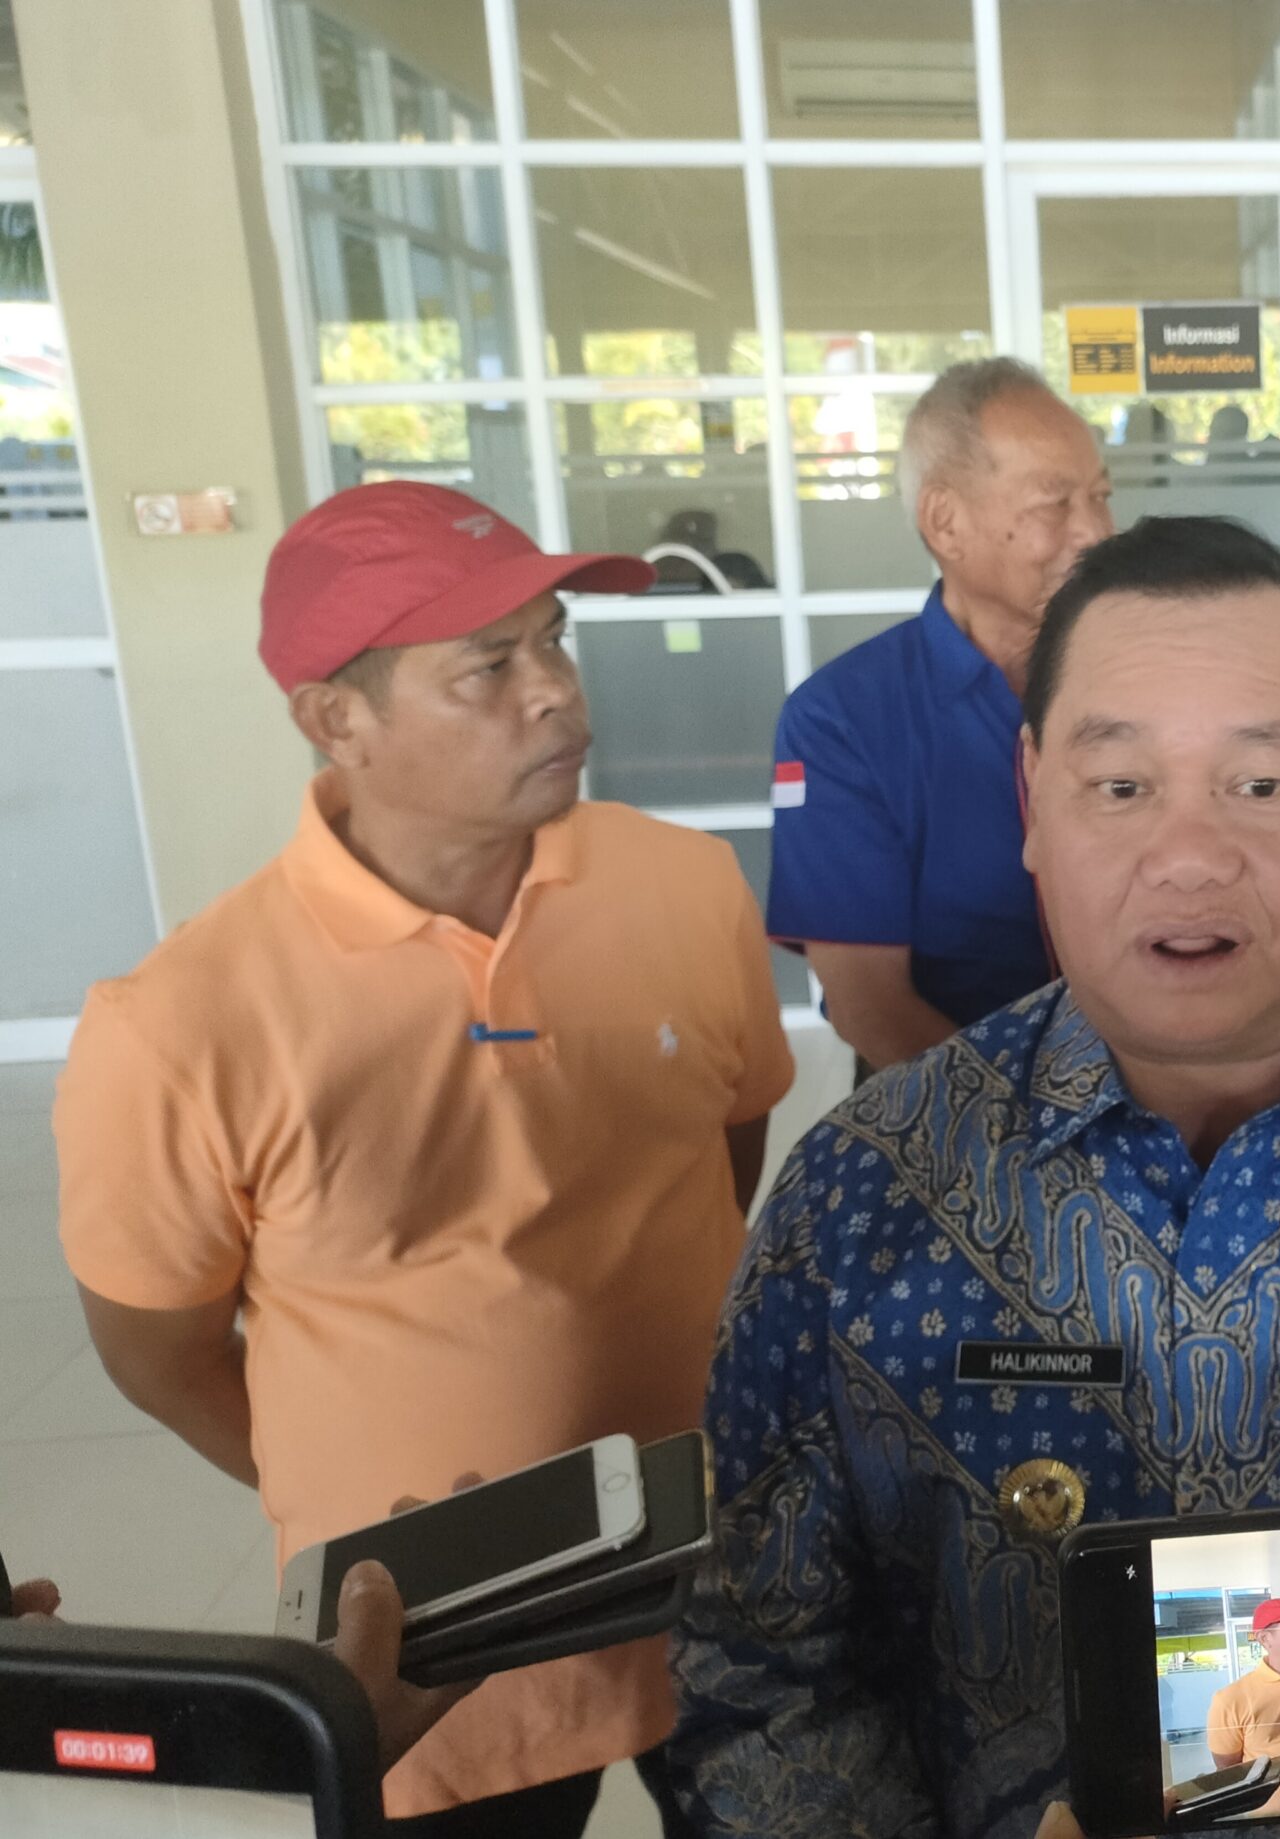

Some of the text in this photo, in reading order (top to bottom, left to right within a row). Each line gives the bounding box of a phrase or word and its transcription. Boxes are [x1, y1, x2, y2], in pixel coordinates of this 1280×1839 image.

[1162, 323, 1240, 346] Informasi
[1150, 350, 1256, 375] Information
[990, 1351, 1093, 1374] HALIKINNOR
